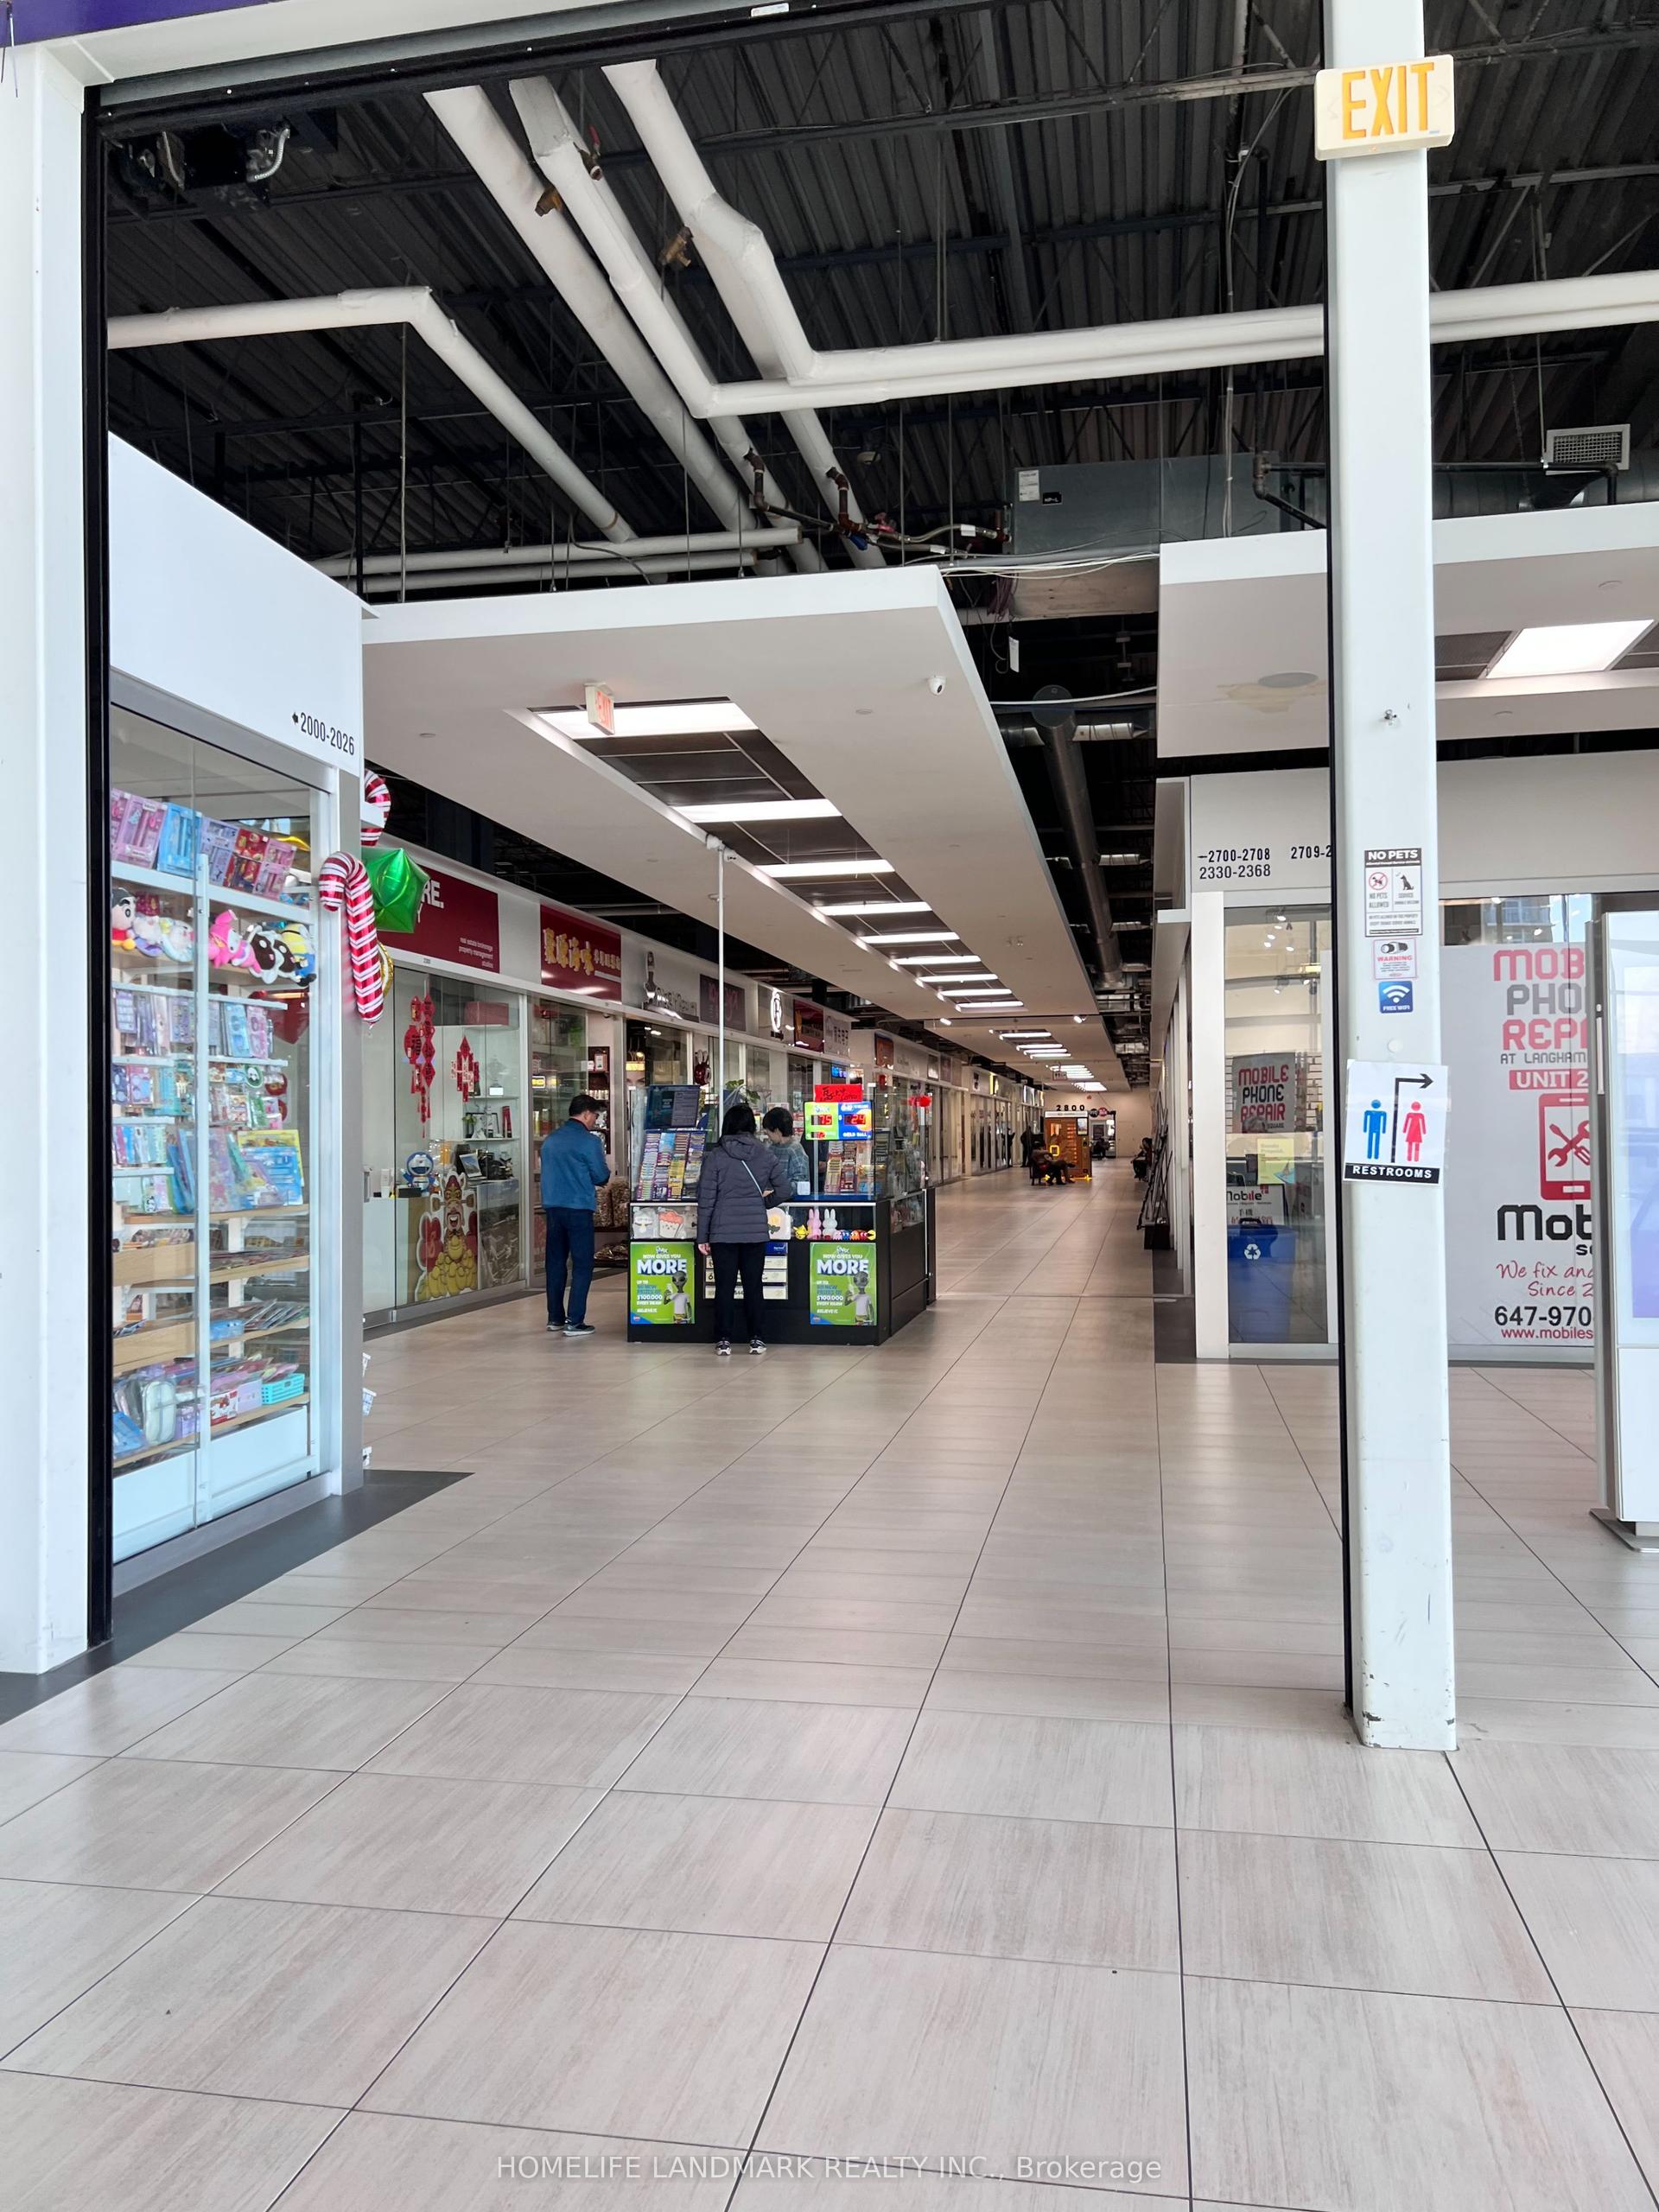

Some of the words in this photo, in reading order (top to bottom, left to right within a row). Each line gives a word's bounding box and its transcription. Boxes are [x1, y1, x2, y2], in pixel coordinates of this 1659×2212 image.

[1342, 62, 1434, 140] EXIT
[301, 712, 354, 755] 2000-2026
[1208, 848, 1270, 862] 2700-2708
[1368, 851, 1386, 861] NO
[1389, 849, 1418, 860] PETS
[1199, 864, 1271, 880] 2330-2368
[1507, 982, 1586, 1015] PHO
[1500, 1053, 1516, 1065] AT
[1524, 1052, 1586, 1065] LANGHAM
[1238, 1064, 1289, 1086] MOBILE
[1516, 1071, 1570, 1088] UNIT
[1243, 1084, 1285, 1104] PHONE
[1352, 1165, 1432, 1179] RESTROOMS
[637, 1259, 688, 1274] MORE
[817, 1259, 869, 1274] MORE
[1496, 1260, 1527, 1279] We
[1533, 1262, 1558, 1279] fix
[1528, 1281, 1575, 1297] Since
[1494, 1306, 1592, 1327] 647-970
[1501, 1327, 1594, 1339] www.mobiles
